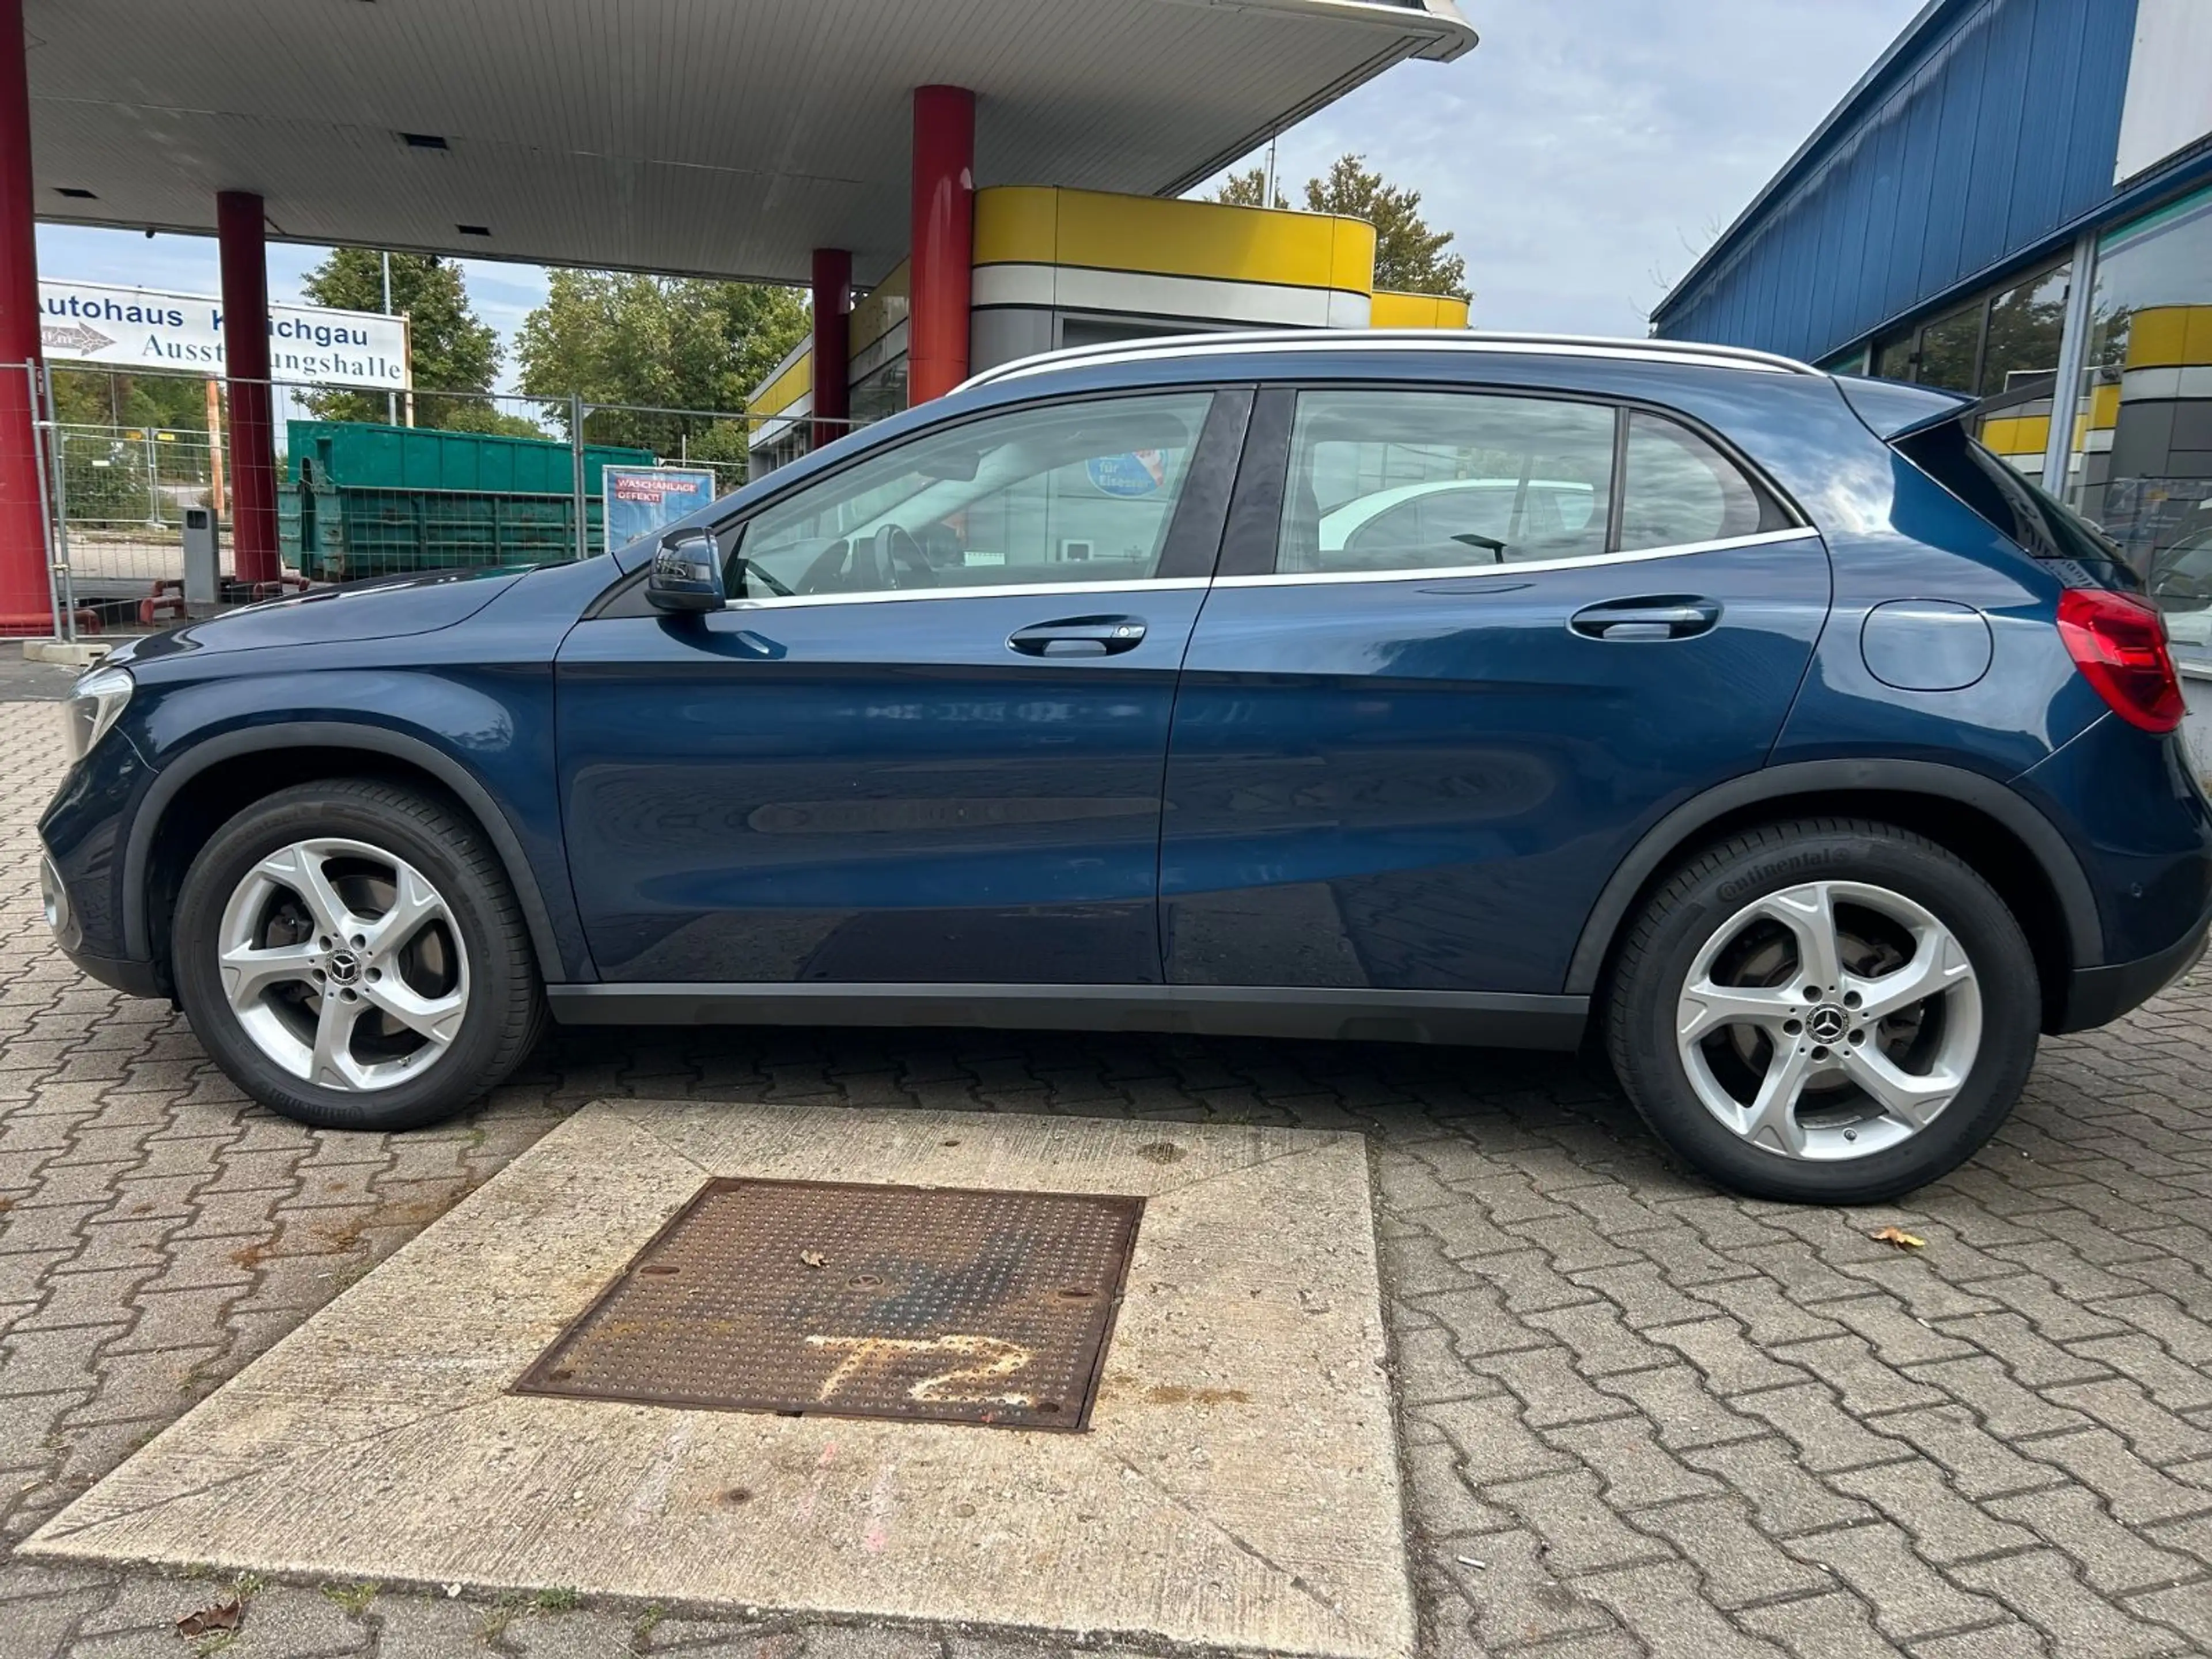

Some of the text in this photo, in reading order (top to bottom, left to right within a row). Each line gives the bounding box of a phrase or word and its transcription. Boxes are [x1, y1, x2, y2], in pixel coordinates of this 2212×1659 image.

[39, 296, 184, 327] utohaus
[618, 479, 695, 492] WASCHANLAGE
[1718, 849, 1831, 901] Continental
